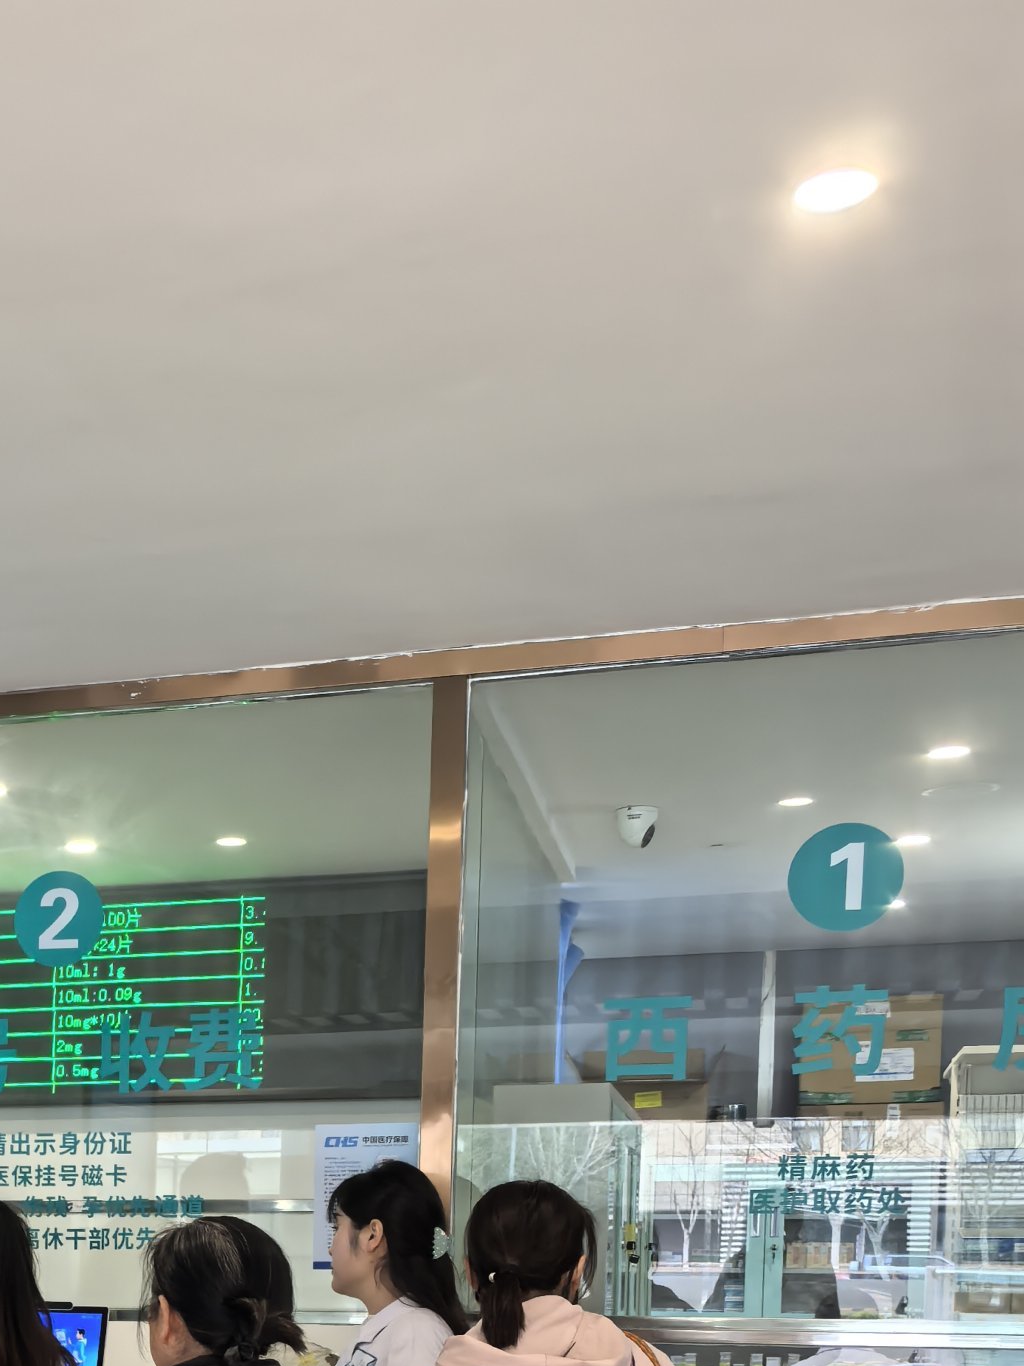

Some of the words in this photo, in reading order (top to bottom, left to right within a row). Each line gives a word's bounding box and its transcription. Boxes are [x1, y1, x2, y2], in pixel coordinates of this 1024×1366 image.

[829, 842, 865, 911] 1
[38, 888, 80, 949] 2
[100, 1008, 262, 1093] 收费
[777, 1153, 875, 1181] 精麻药
[749, 1185, 907, 1215] 医护取药处
